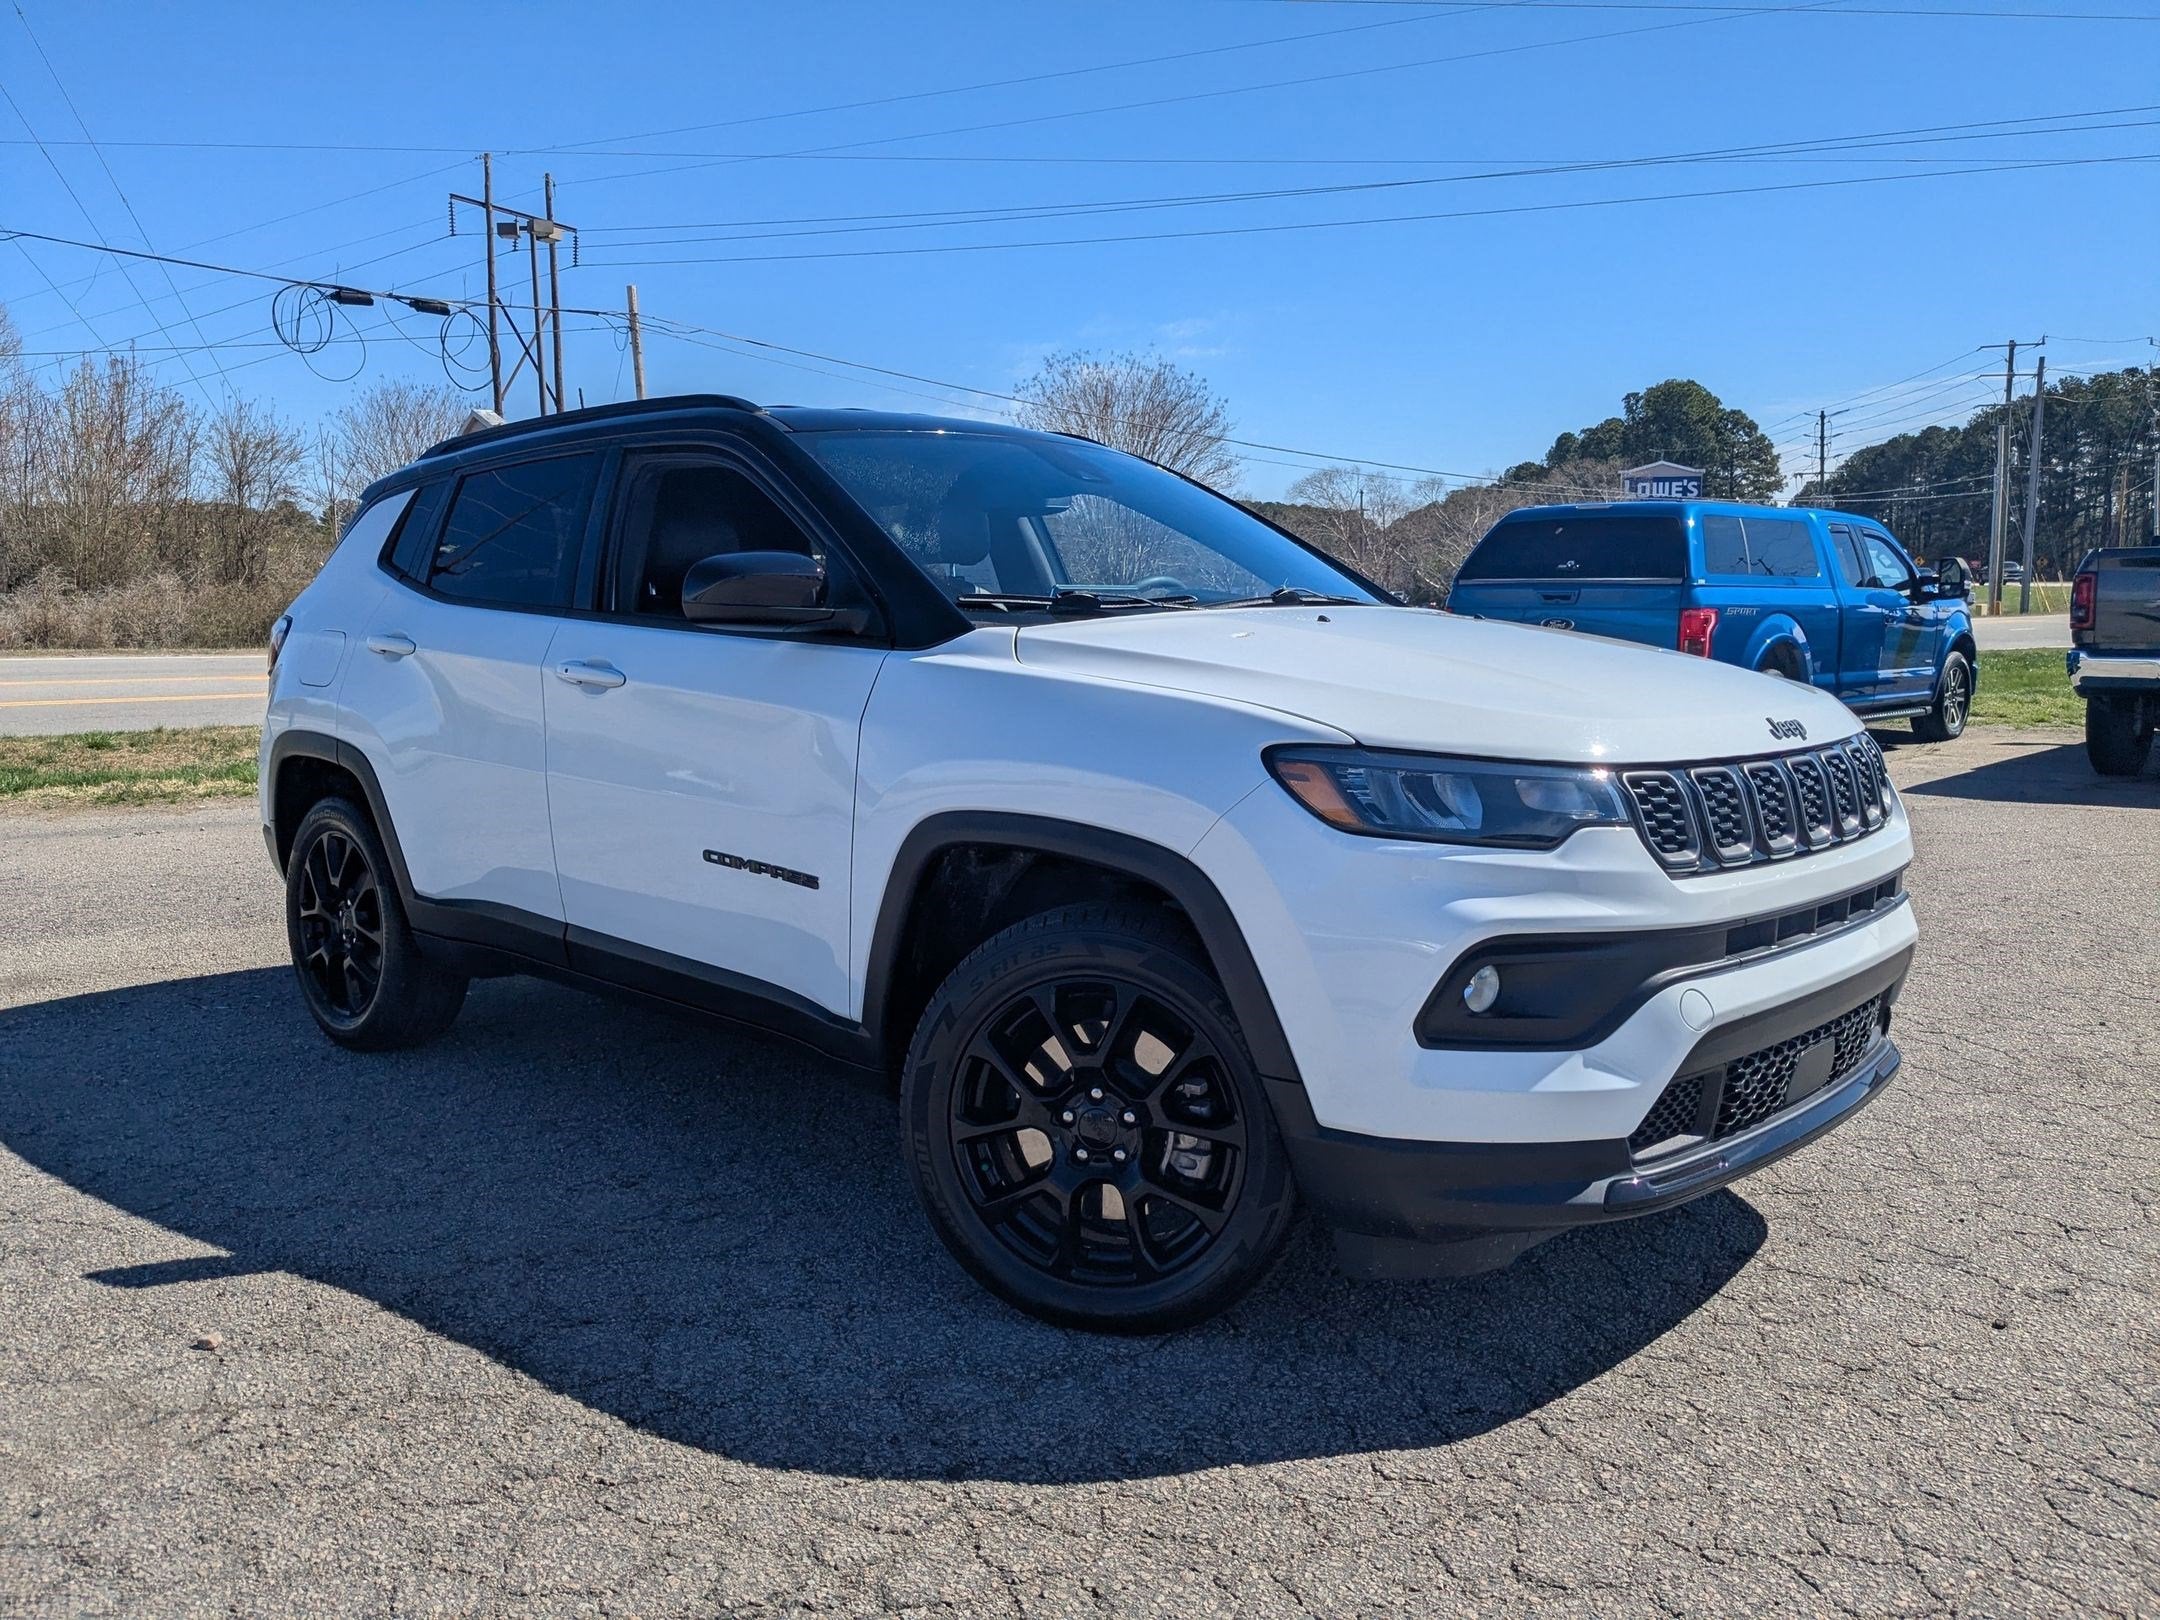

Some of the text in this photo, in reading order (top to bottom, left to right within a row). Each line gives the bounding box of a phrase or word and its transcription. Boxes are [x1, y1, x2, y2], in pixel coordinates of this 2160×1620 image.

[1623, 479, 1699, 497] LOWE'S
[1725, 606, 1760, 616] SPORT
[1765, 717, 1808, 741] Jeep
[702, 849, 820, 890] COMPASS
